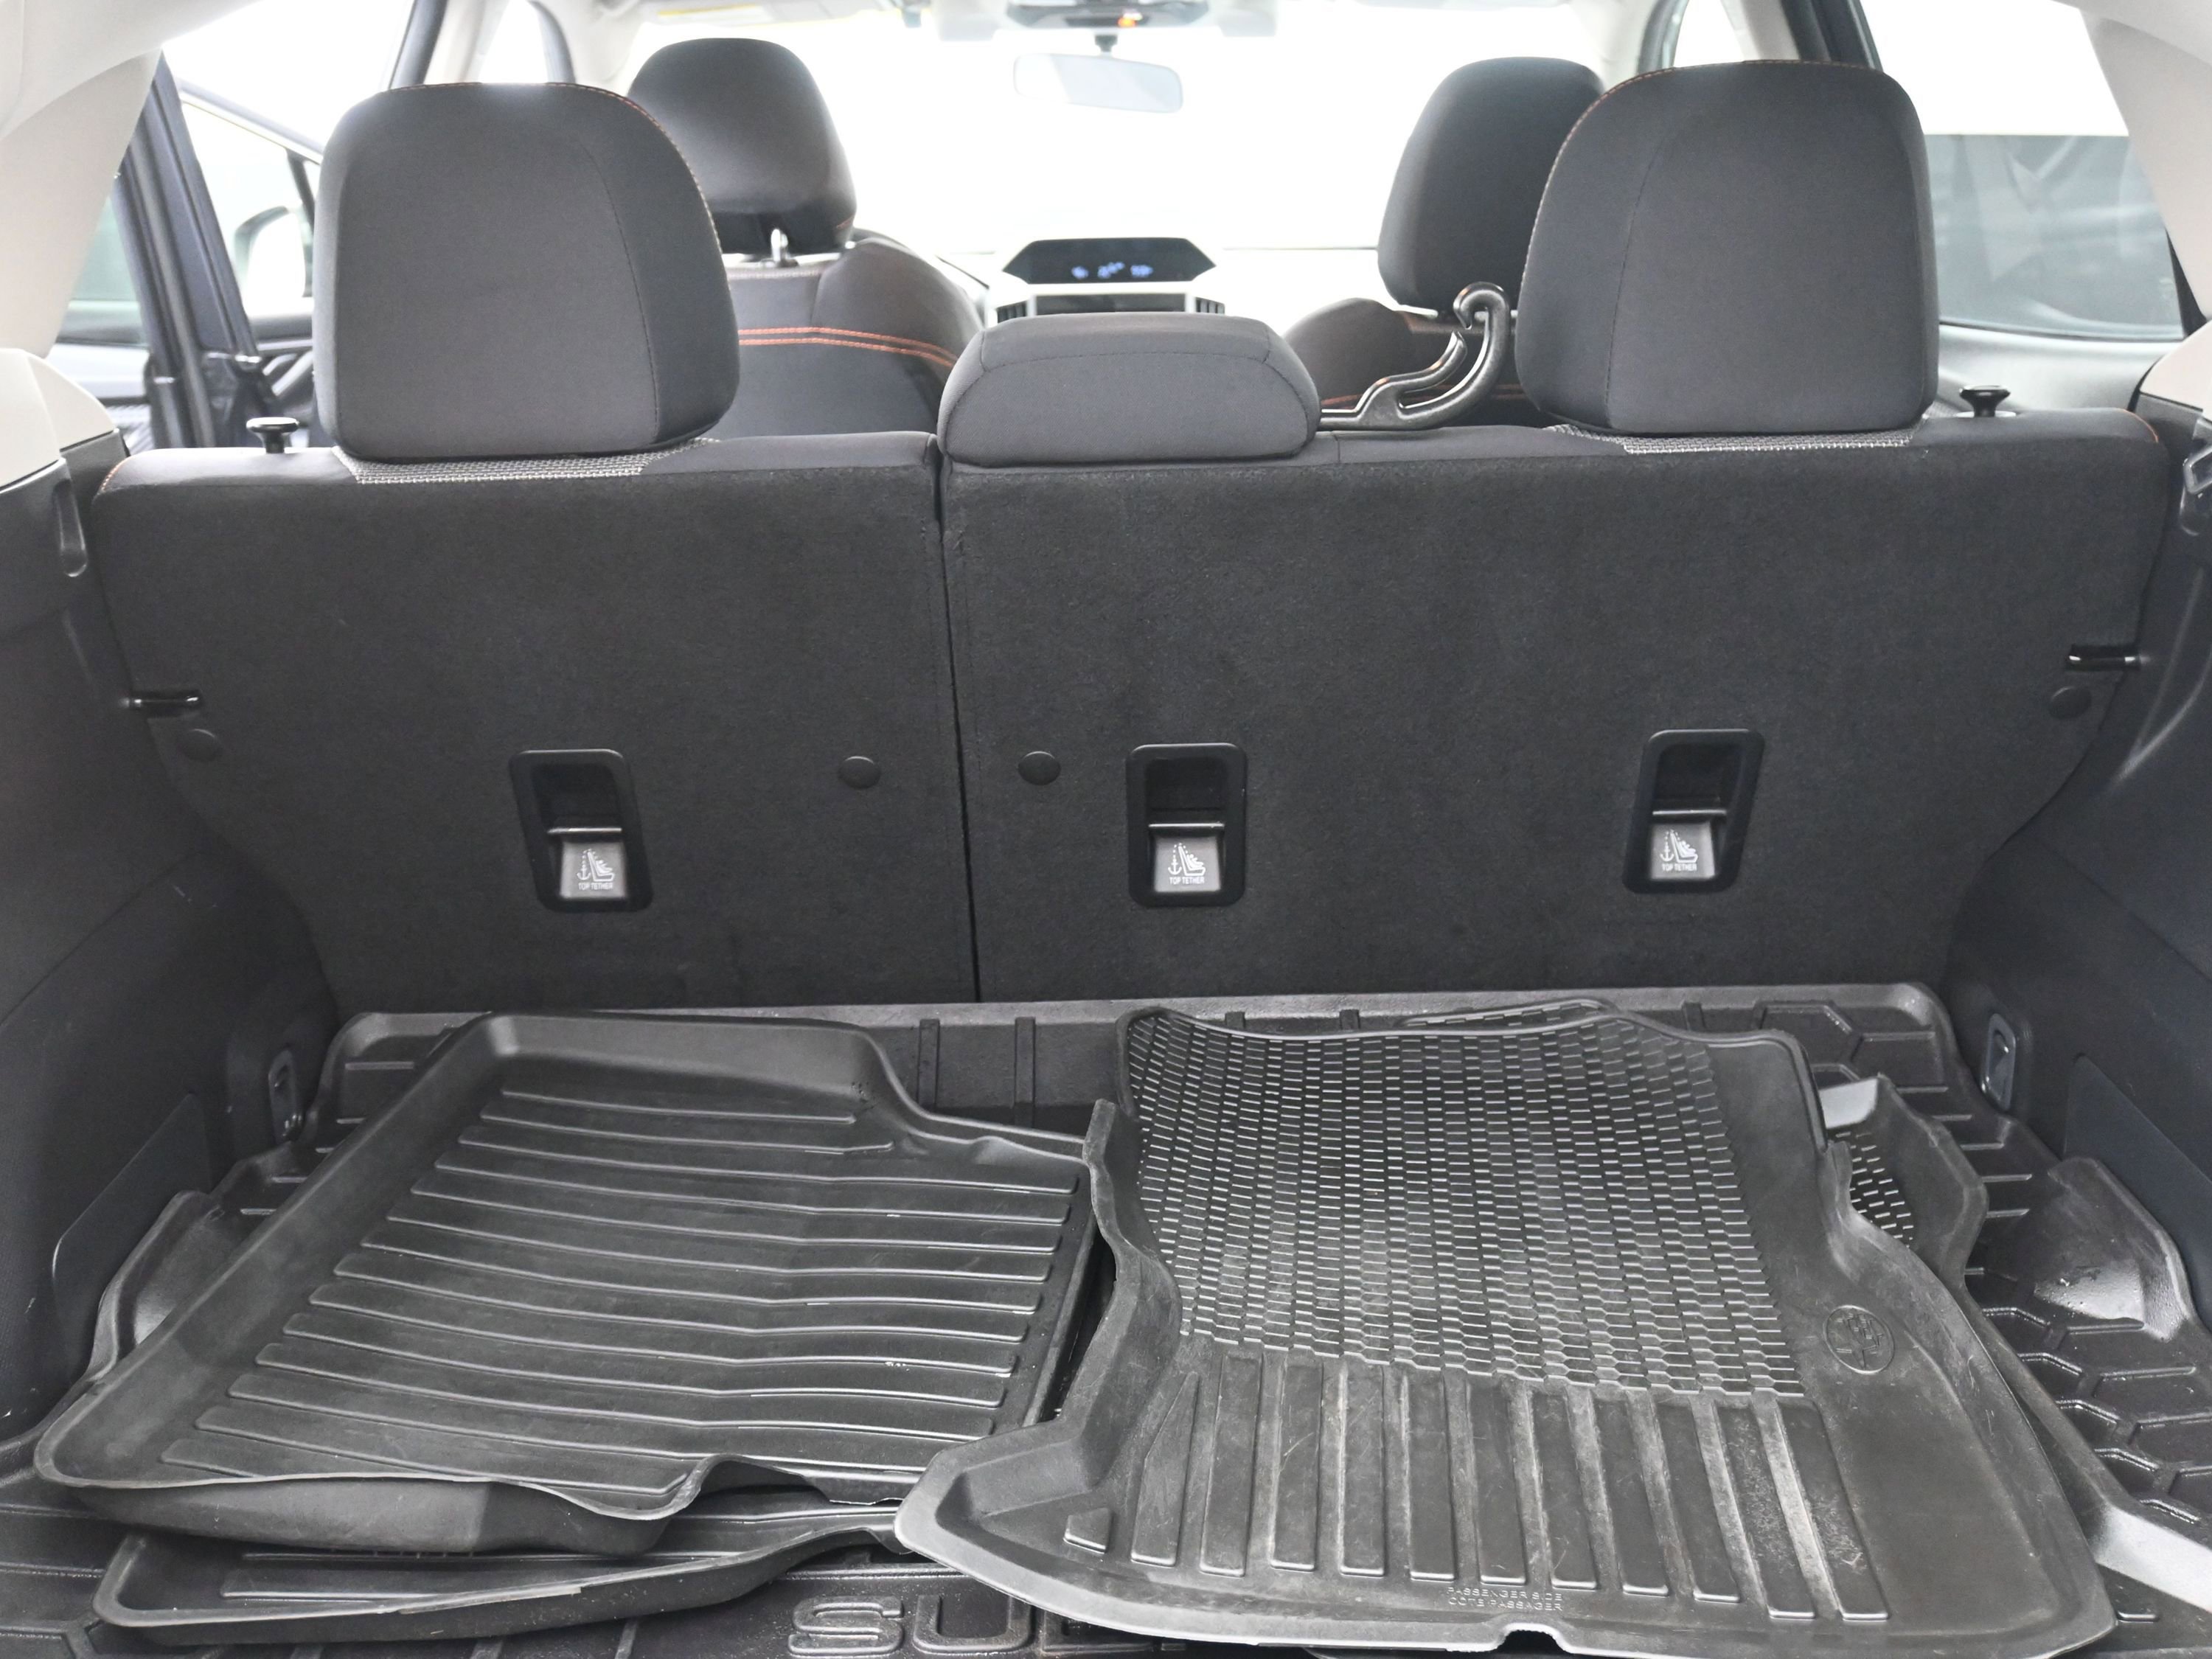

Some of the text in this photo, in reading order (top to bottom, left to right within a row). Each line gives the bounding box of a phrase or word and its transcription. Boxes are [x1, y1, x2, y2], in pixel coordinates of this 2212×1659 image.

[1662, 863, 1697, 872] TOP TETHER
[1169, 877, 1181, 885] TOP
[578, 883, 591, 891] TOP
[1447, 1587, 1562, 1601] PASSENGER SIDE
[1487, 1599, 1562, 1611] PASSAGER
